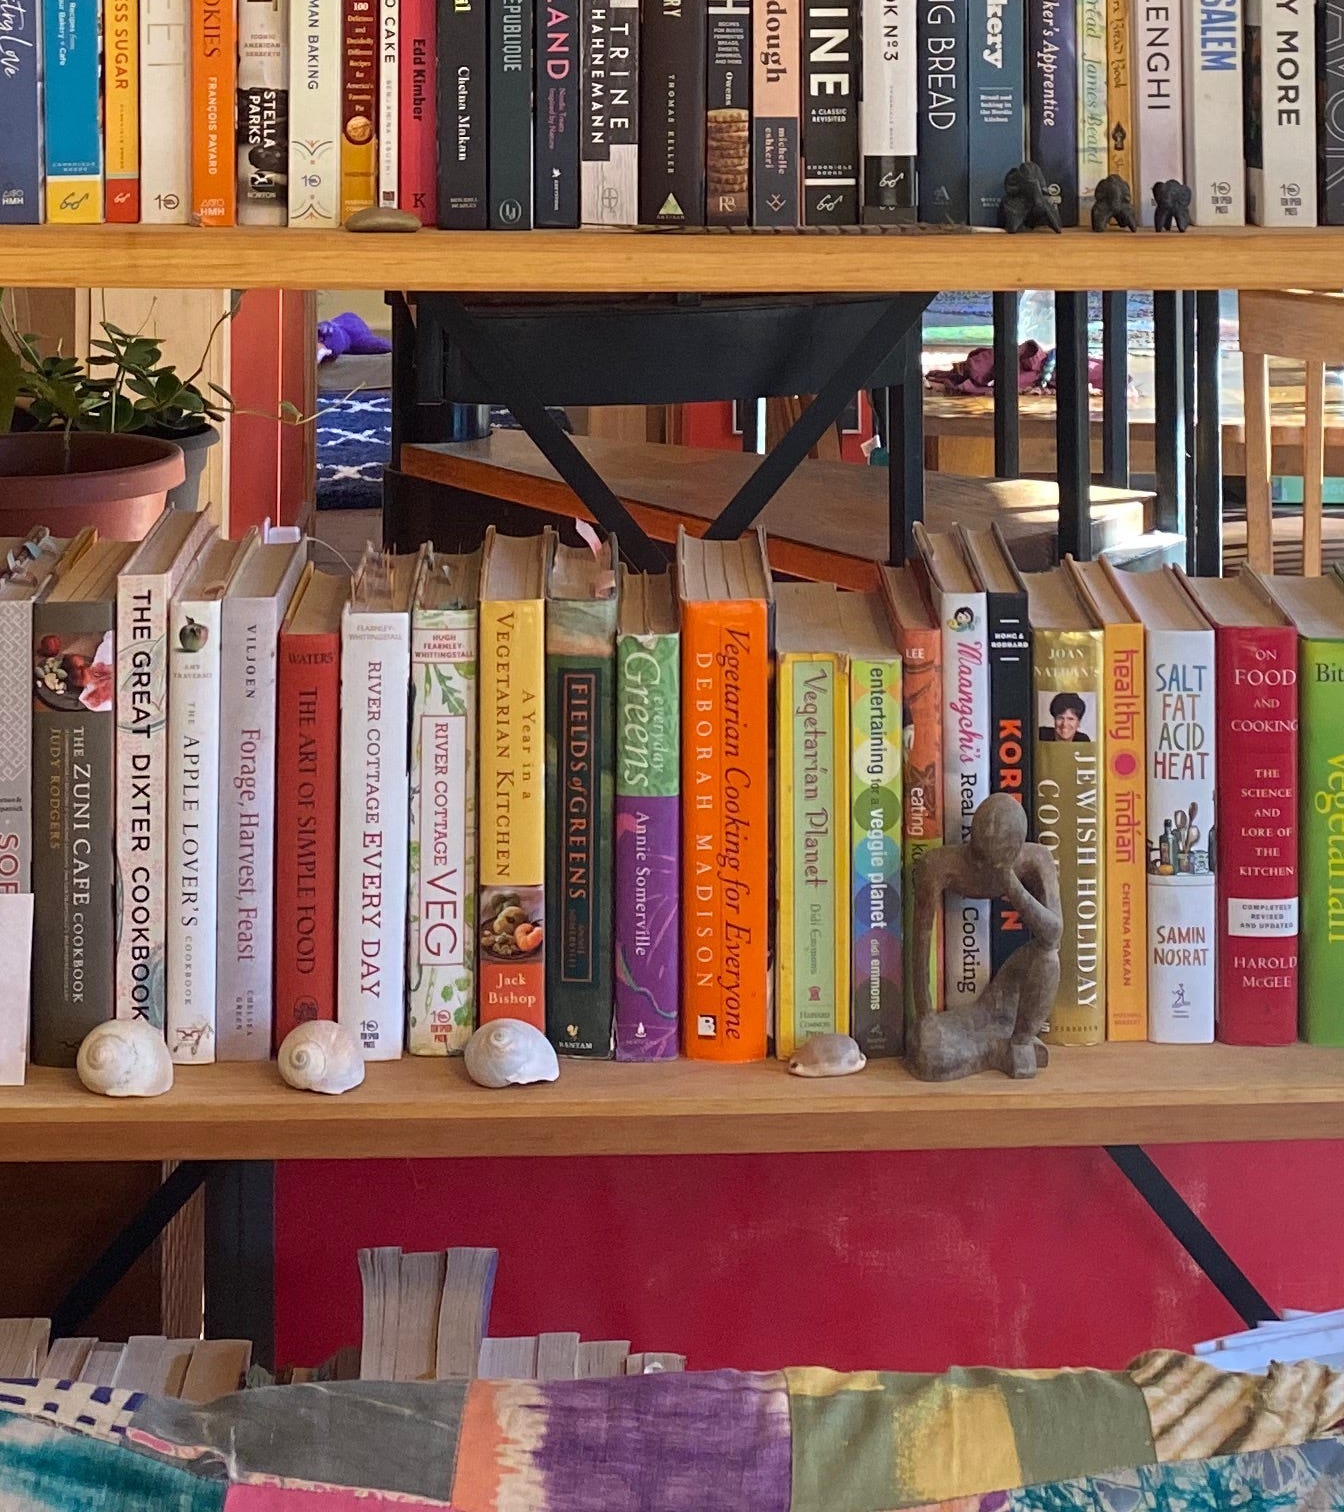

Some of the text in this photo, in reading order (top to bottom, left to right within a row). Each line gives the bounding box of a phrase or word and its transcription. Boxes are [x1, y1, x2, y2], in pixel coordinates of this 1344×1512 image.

[115, 28, 129, 90] SUGAR
[307, 34, 320, 90] BAKING
[927, 37, 956, 130] BREAD
[1276, 30, 1301, 127] MORE
[248, 94, 262, 144] PARKS
[263, 90, 276, 149] STELLA
[245, 624, 257, 700] VILJOEN
[905, 648, 925, 659] LEE
[1155, 664, 1207, 692] SALT
[1234, 668, 1297, 686] FOOD
[1255, 649, 1277, 661] ON
[1162, 693, 1201, 721] FAT
[1231, 719, 1298, 733] COOKING
[494, 610, 515, 878] VEGETARIAN KITCHEN
[1158, 723, 1205, 751] ACID
[1153, 752, 1209, 780] HEAT
[130, 589, 152, 1021] THE GREAT DIXTER COOKBOOK
[695, 652, 713, 988] DEBORAH MADISON
[234, 728, 261, 962] Forage, Harvest, Feast
[425, 722, 457, 957] RIVER COTTAGE VEG
[716, 625, 751, 1040] Vegetarian Cooking for Everyone
[634, 811, 651, 956] Annie Somerville
[1074, 750, 1098, 1009] JEWISH HOLIDAY
[1153, 948, 1209, 967] NOSRAT
[1156, 926, 1206, 944] SAMIN
[494, 973, 526, 988] Jack
[1233, 956, 1297, 969] HAROLD
[488, 991, 536, 1007] Bishop
